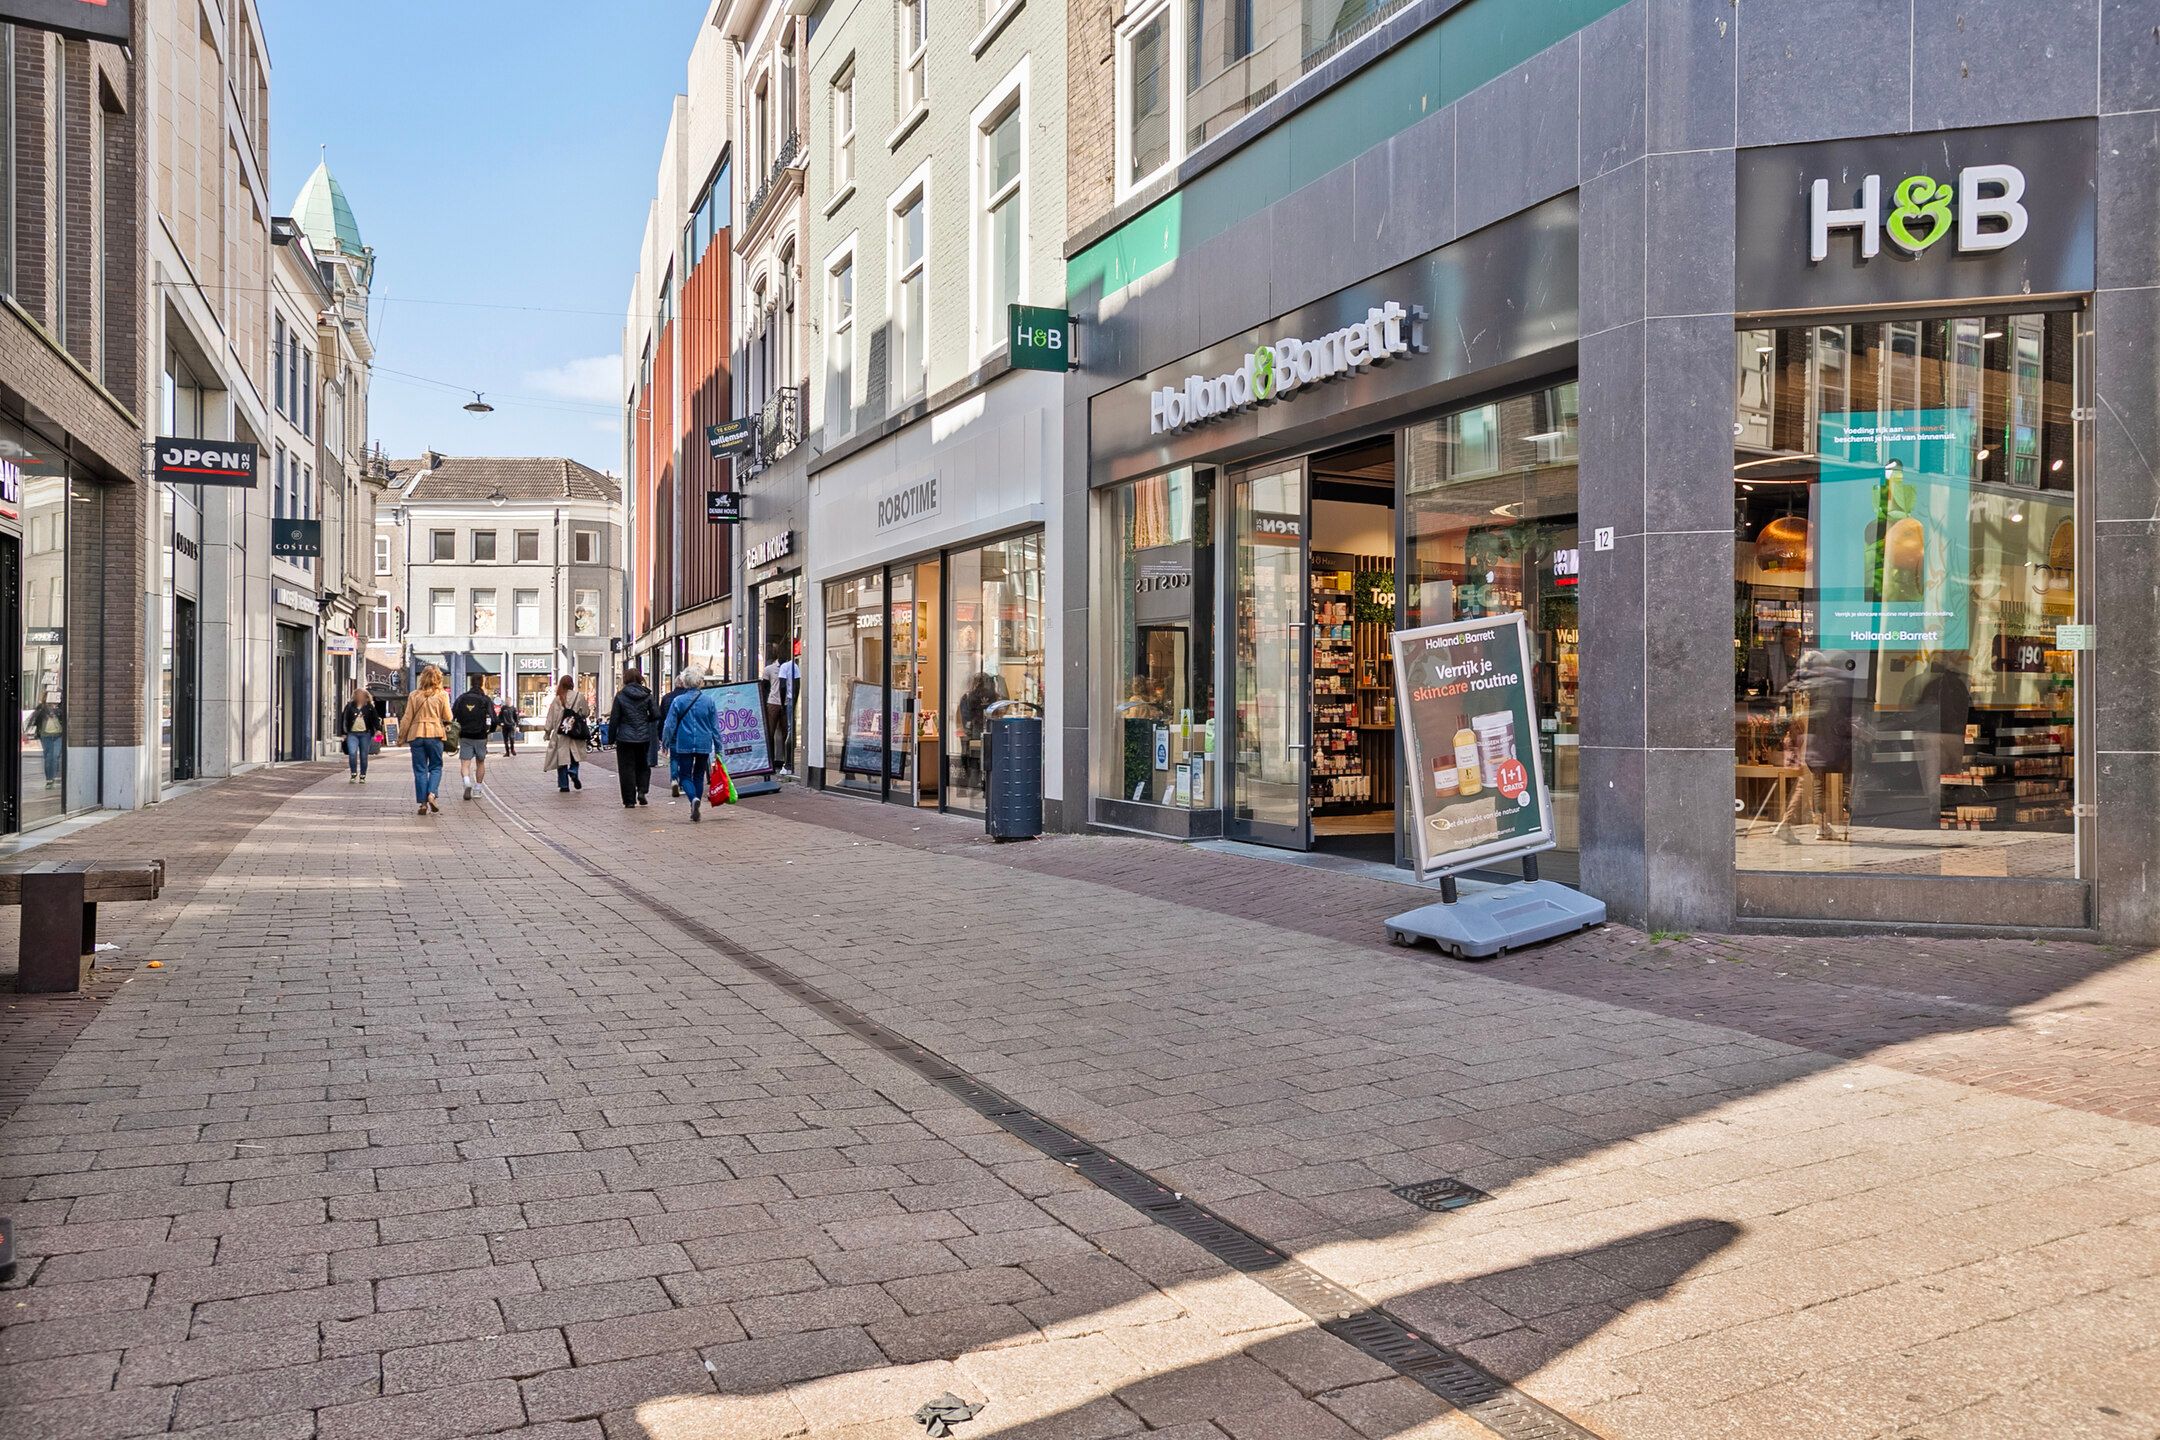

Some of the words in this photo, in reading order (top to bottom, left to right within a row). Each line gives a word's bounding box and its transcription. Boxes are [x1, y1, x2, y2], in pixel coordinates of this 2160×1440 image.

[1811, 164, 2028, 261] H&B
[1017, 325, 1062, 349] H&B
[1151, 300, 1407, 434] Holland&Barrett
[710, 431, 748, 446] willemsen
[1834, 435, 1874, 443] beschermt
[1883, 434, 1901, 442] huid
[1843, 427, 1874, 435] Voeding
[241, 453, 250, 470] 32
[878, 479, 936, 528] ROBOTIME
[275, 543, 317, 551] COSTES
[1599, 531, 1609, 548] 12
[1371, 587, 1395, 609] Top
[1425, 630, 1496, 650] Holland&Barrett
[1850, 630, 1938, 641] Holland&Barrett
[519, 658, 548, 669] SIEBEL
[1435, 660, 1479, 680] Verrijk
[1480, 658, 1493, 676] je
[1413, 681, 1469, 702] skincare
[1470, 673, 1518, 692] routine
[721, 728, 760, 745] ORTING
[1501, 765, 1523, 785] 1+1
[1464, 815, 1483, 825] kracht
[1502, 806, 1520, 816] natuur
